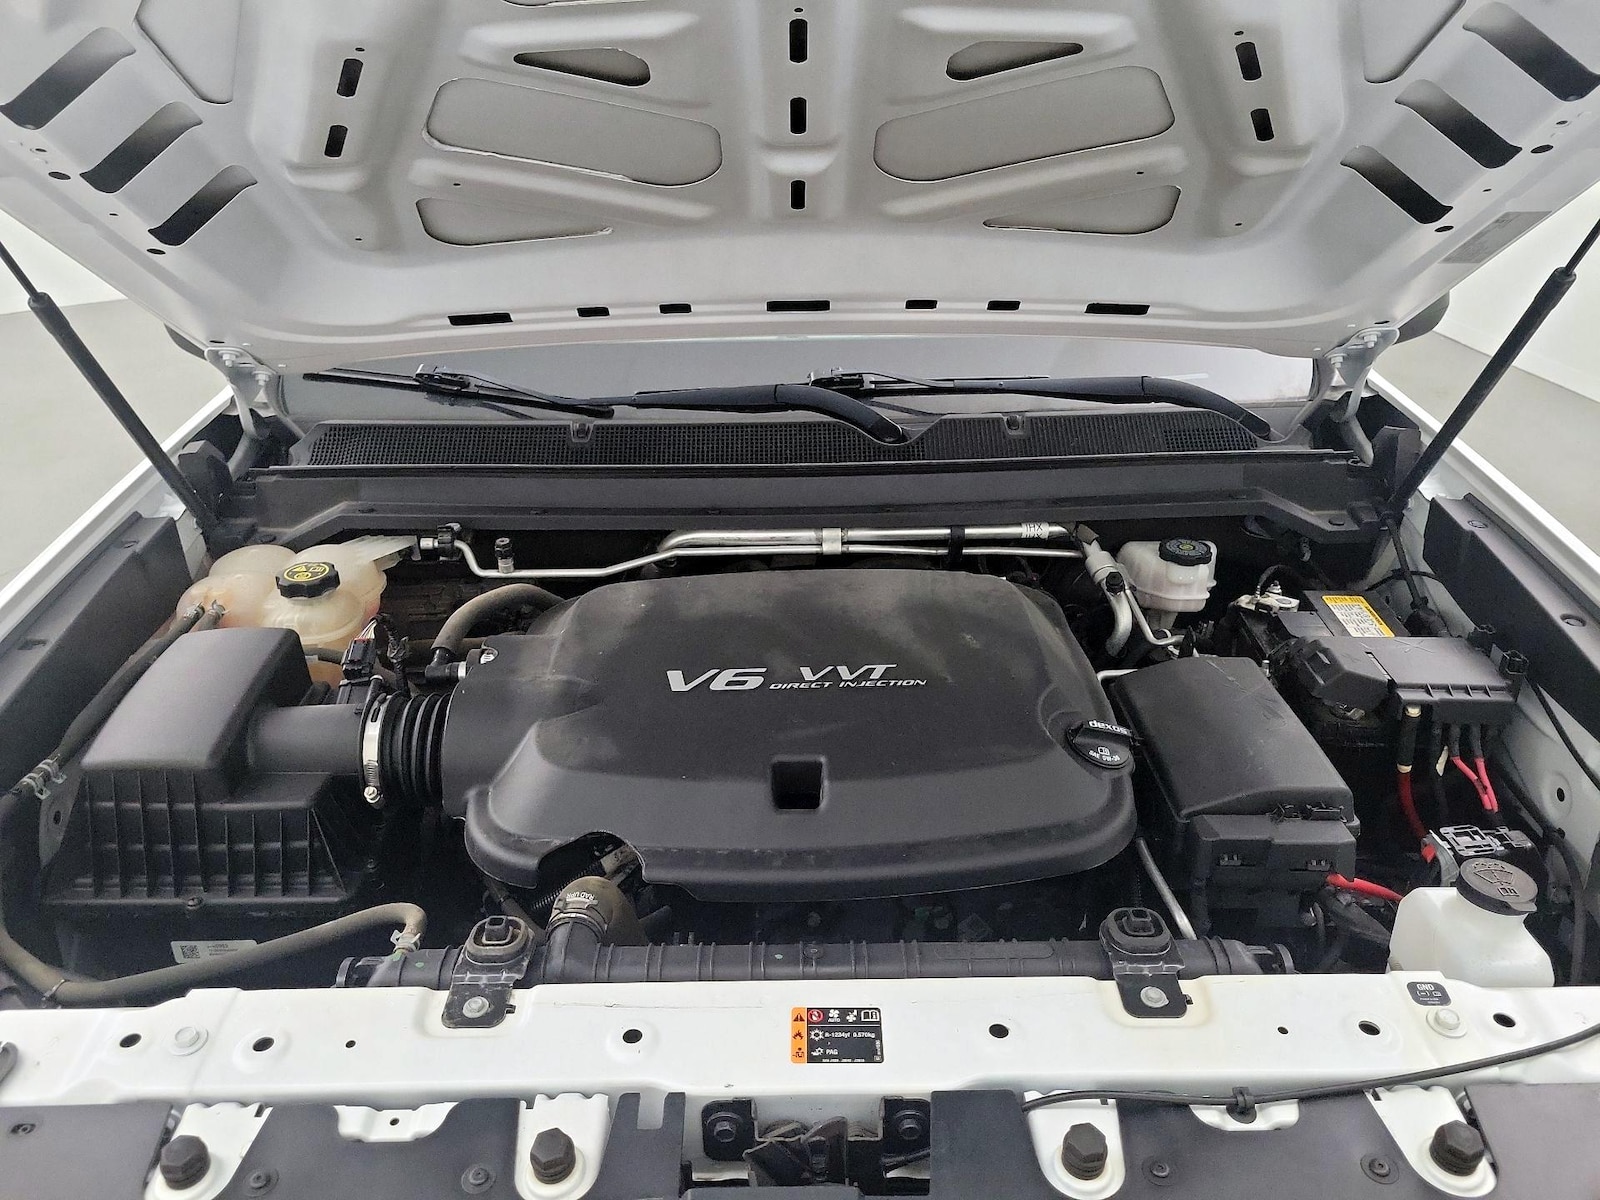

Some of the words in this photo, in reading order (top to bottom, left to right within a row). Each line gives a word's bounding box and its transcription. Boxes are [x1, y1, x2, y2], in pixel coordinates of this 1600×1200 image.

[666, 667, 768, 692] V6
[799, 663, 898, 681] VVT
[768, 681, 834, 691] DIRECT
[838, 678, 928, 689] INJECTION
[1088, 719, 1128, 735] dexos
[1416, 983, 1435, 991] GND
[825, 1048, 839, 1056] PAG
